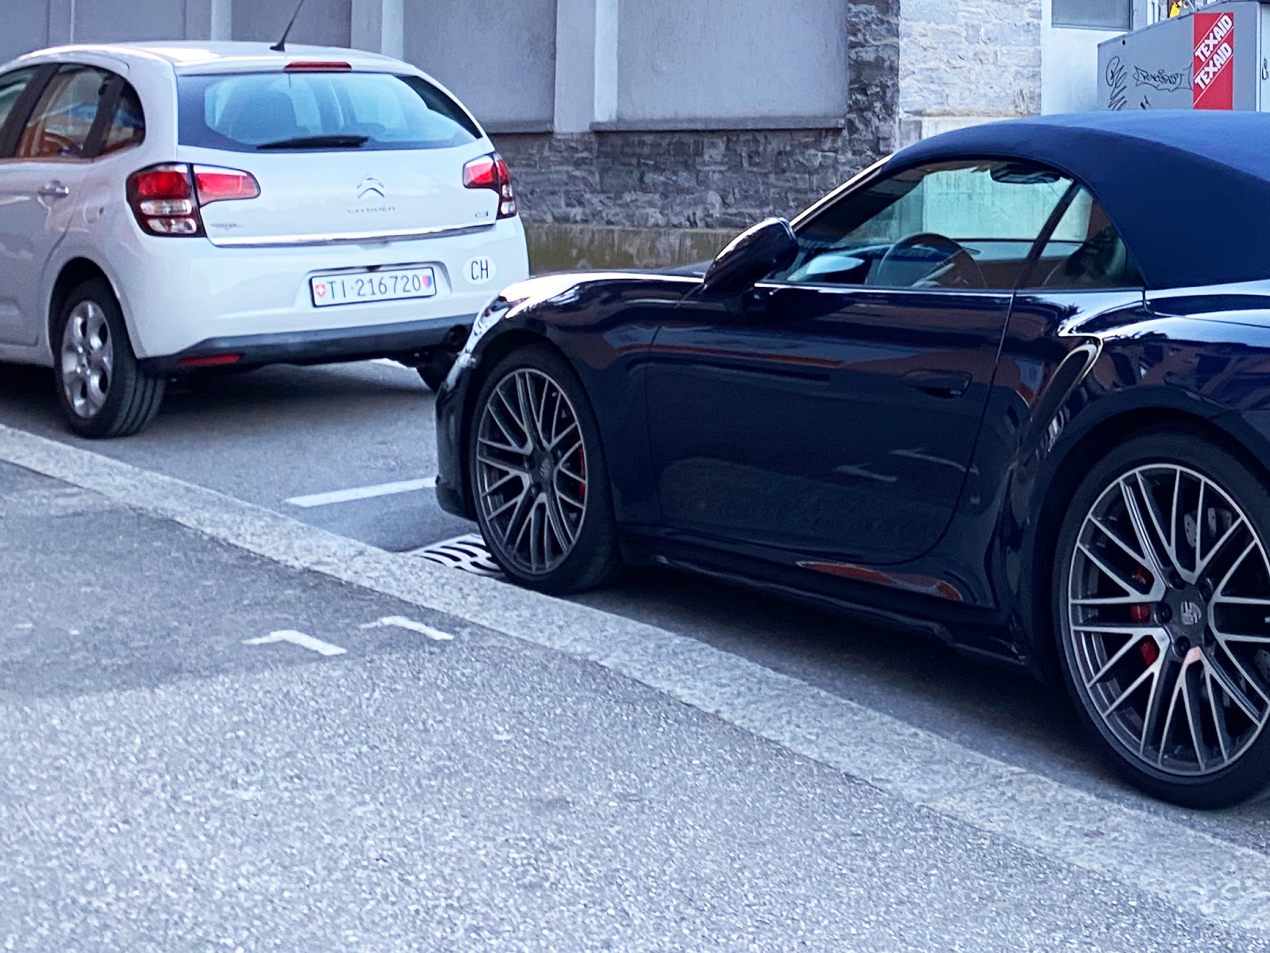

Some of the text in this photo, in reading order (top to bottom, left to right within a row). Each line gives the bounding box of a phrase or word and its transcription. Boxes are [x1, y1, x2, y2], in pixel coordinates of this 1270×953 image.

[1194, 15, 1233, 62] TEXAID
[1194, 42, 1233, 90] TEXAID
[470, 259, 490, 281] CH
